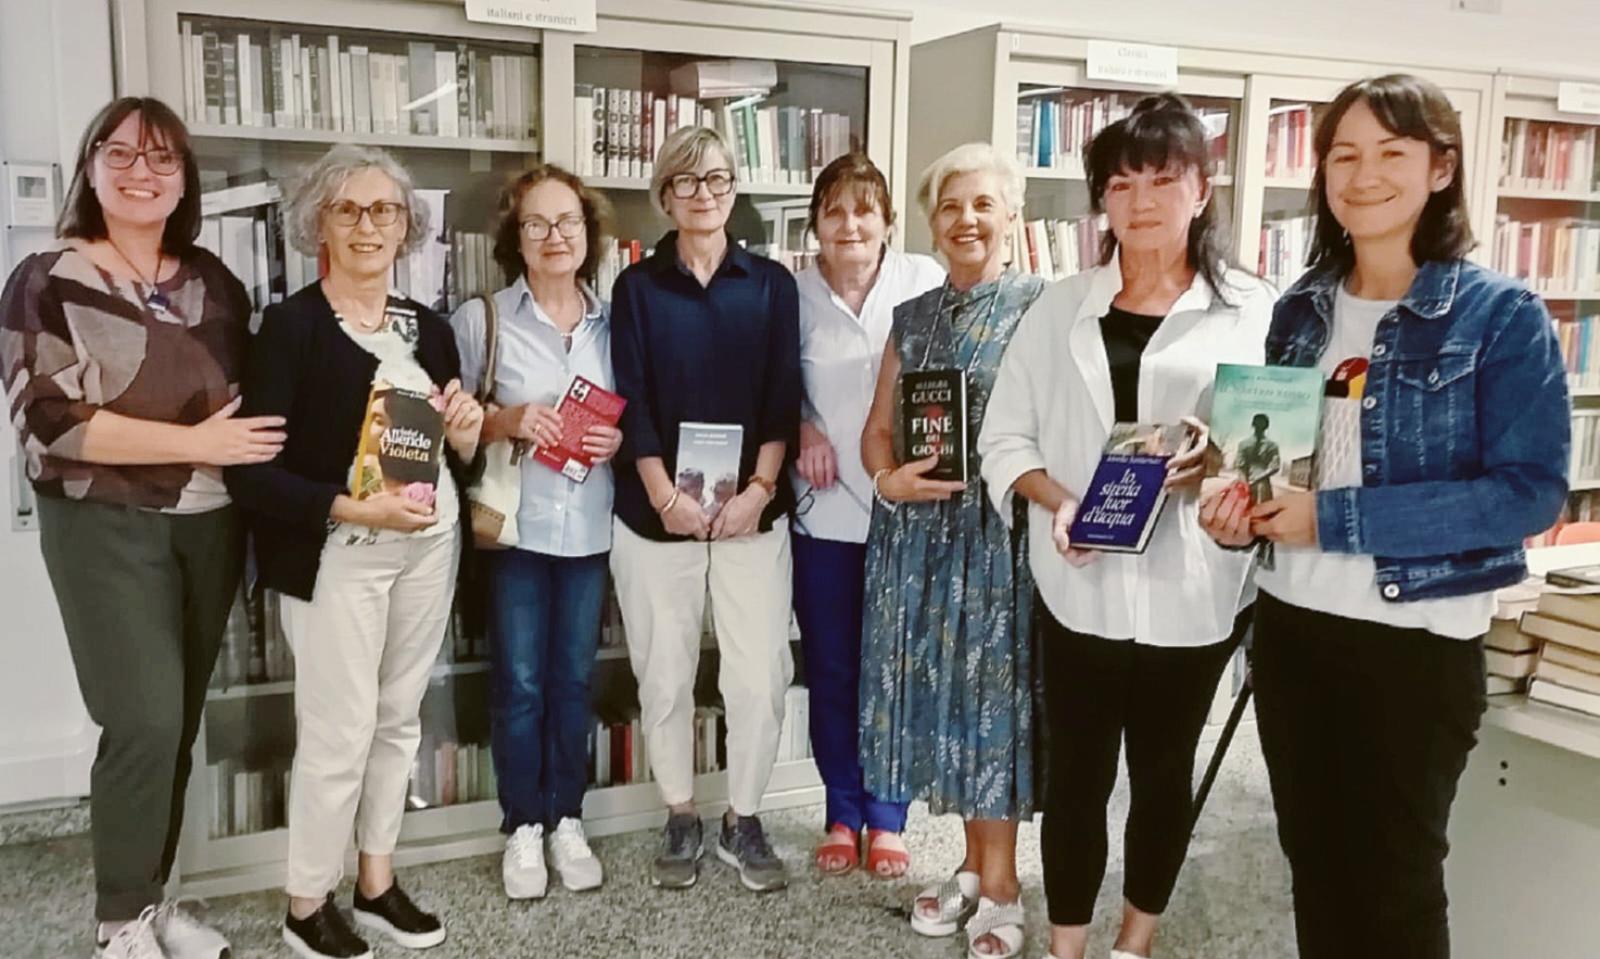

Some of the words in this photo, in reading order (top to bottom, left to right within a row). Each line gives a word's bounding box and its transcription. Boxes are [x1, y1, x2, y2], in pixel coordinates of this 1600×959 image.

[487, 8, 523, 21] italiani
[526, 13, 532, 21] e
[535, 13, 577, 25] stranieri
[911, 389, 952, 404] GUCCI
[912, 415, 954, 434] FINE
[379, 427, 432, 449] Allende
[380, 442, 430, 462] Violeta
[912, 444, 954, 457] GIOCHI
[1099, 481, 1142, 497] sirena
[1101, 494, 1133, 513] fuor
[1081, 505, 1136, 529] d'acqua
